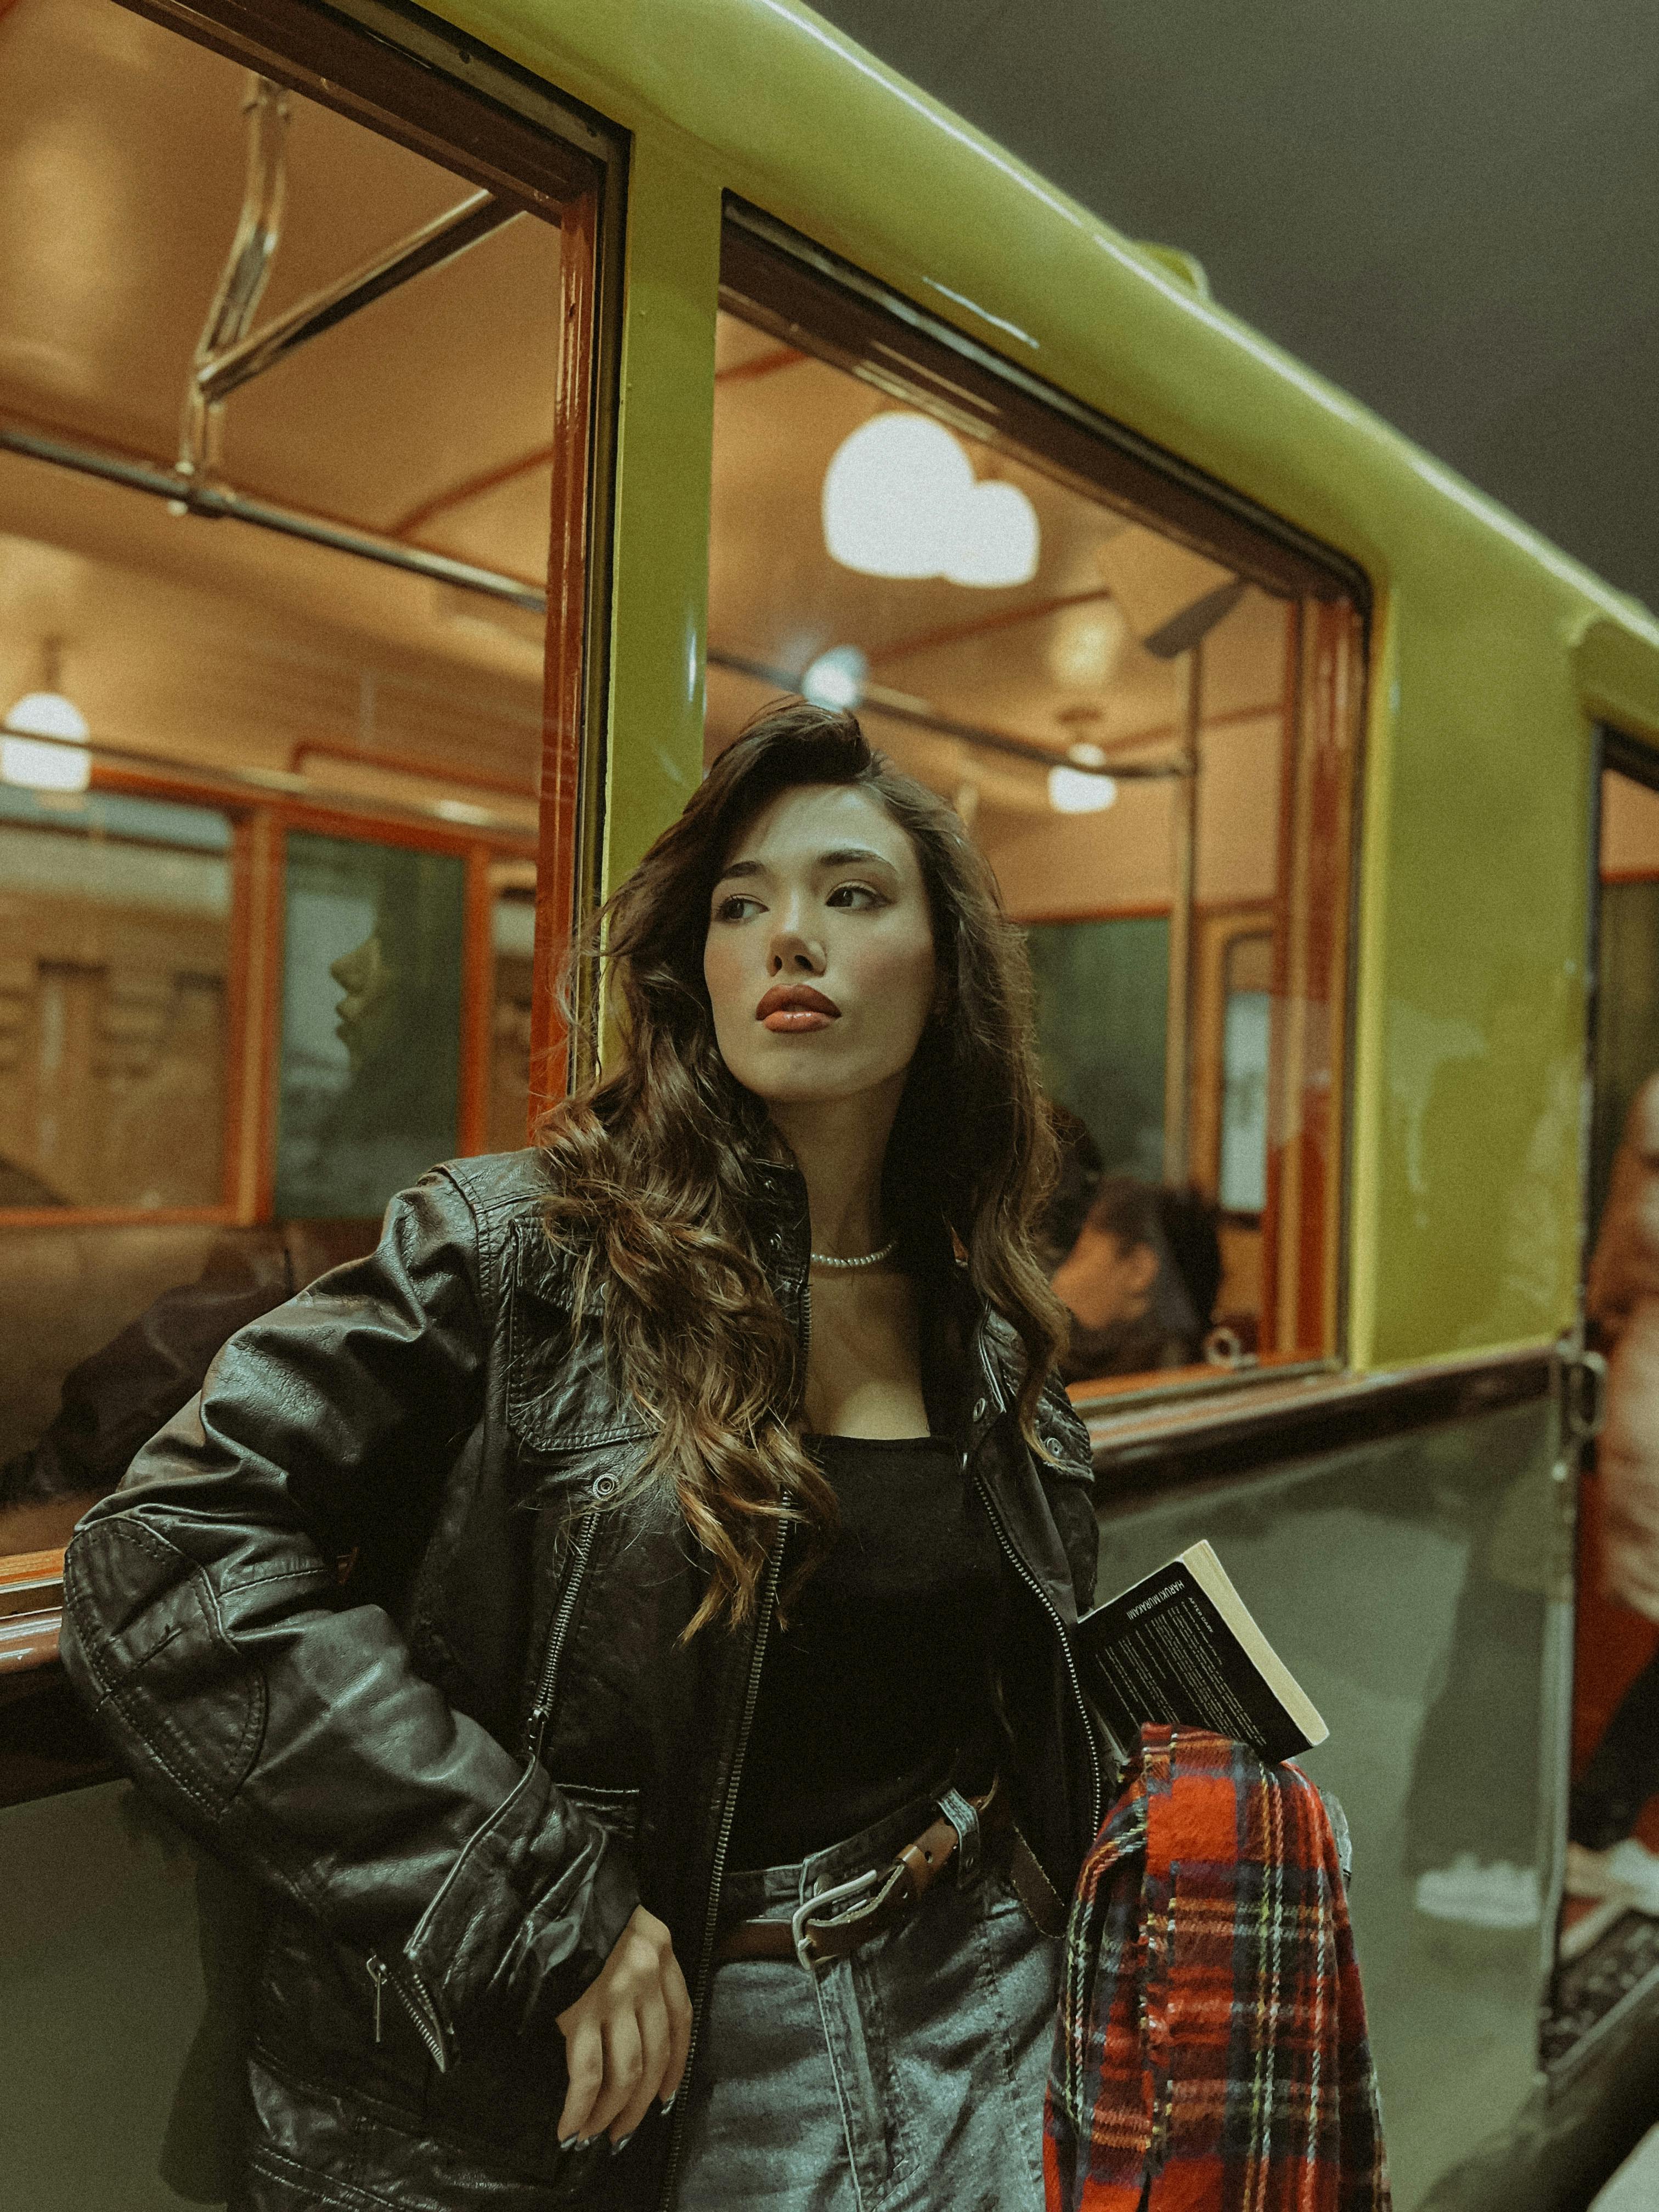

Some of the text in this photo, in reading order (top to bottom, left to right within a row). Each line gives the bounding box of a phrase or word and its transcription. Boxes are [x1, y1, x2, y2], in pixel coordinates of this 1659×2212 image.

[1126, 1579, 1185, 1621] HARUKI MURAKAMI
[1188, 1597, 1203, 1617] AFTER
